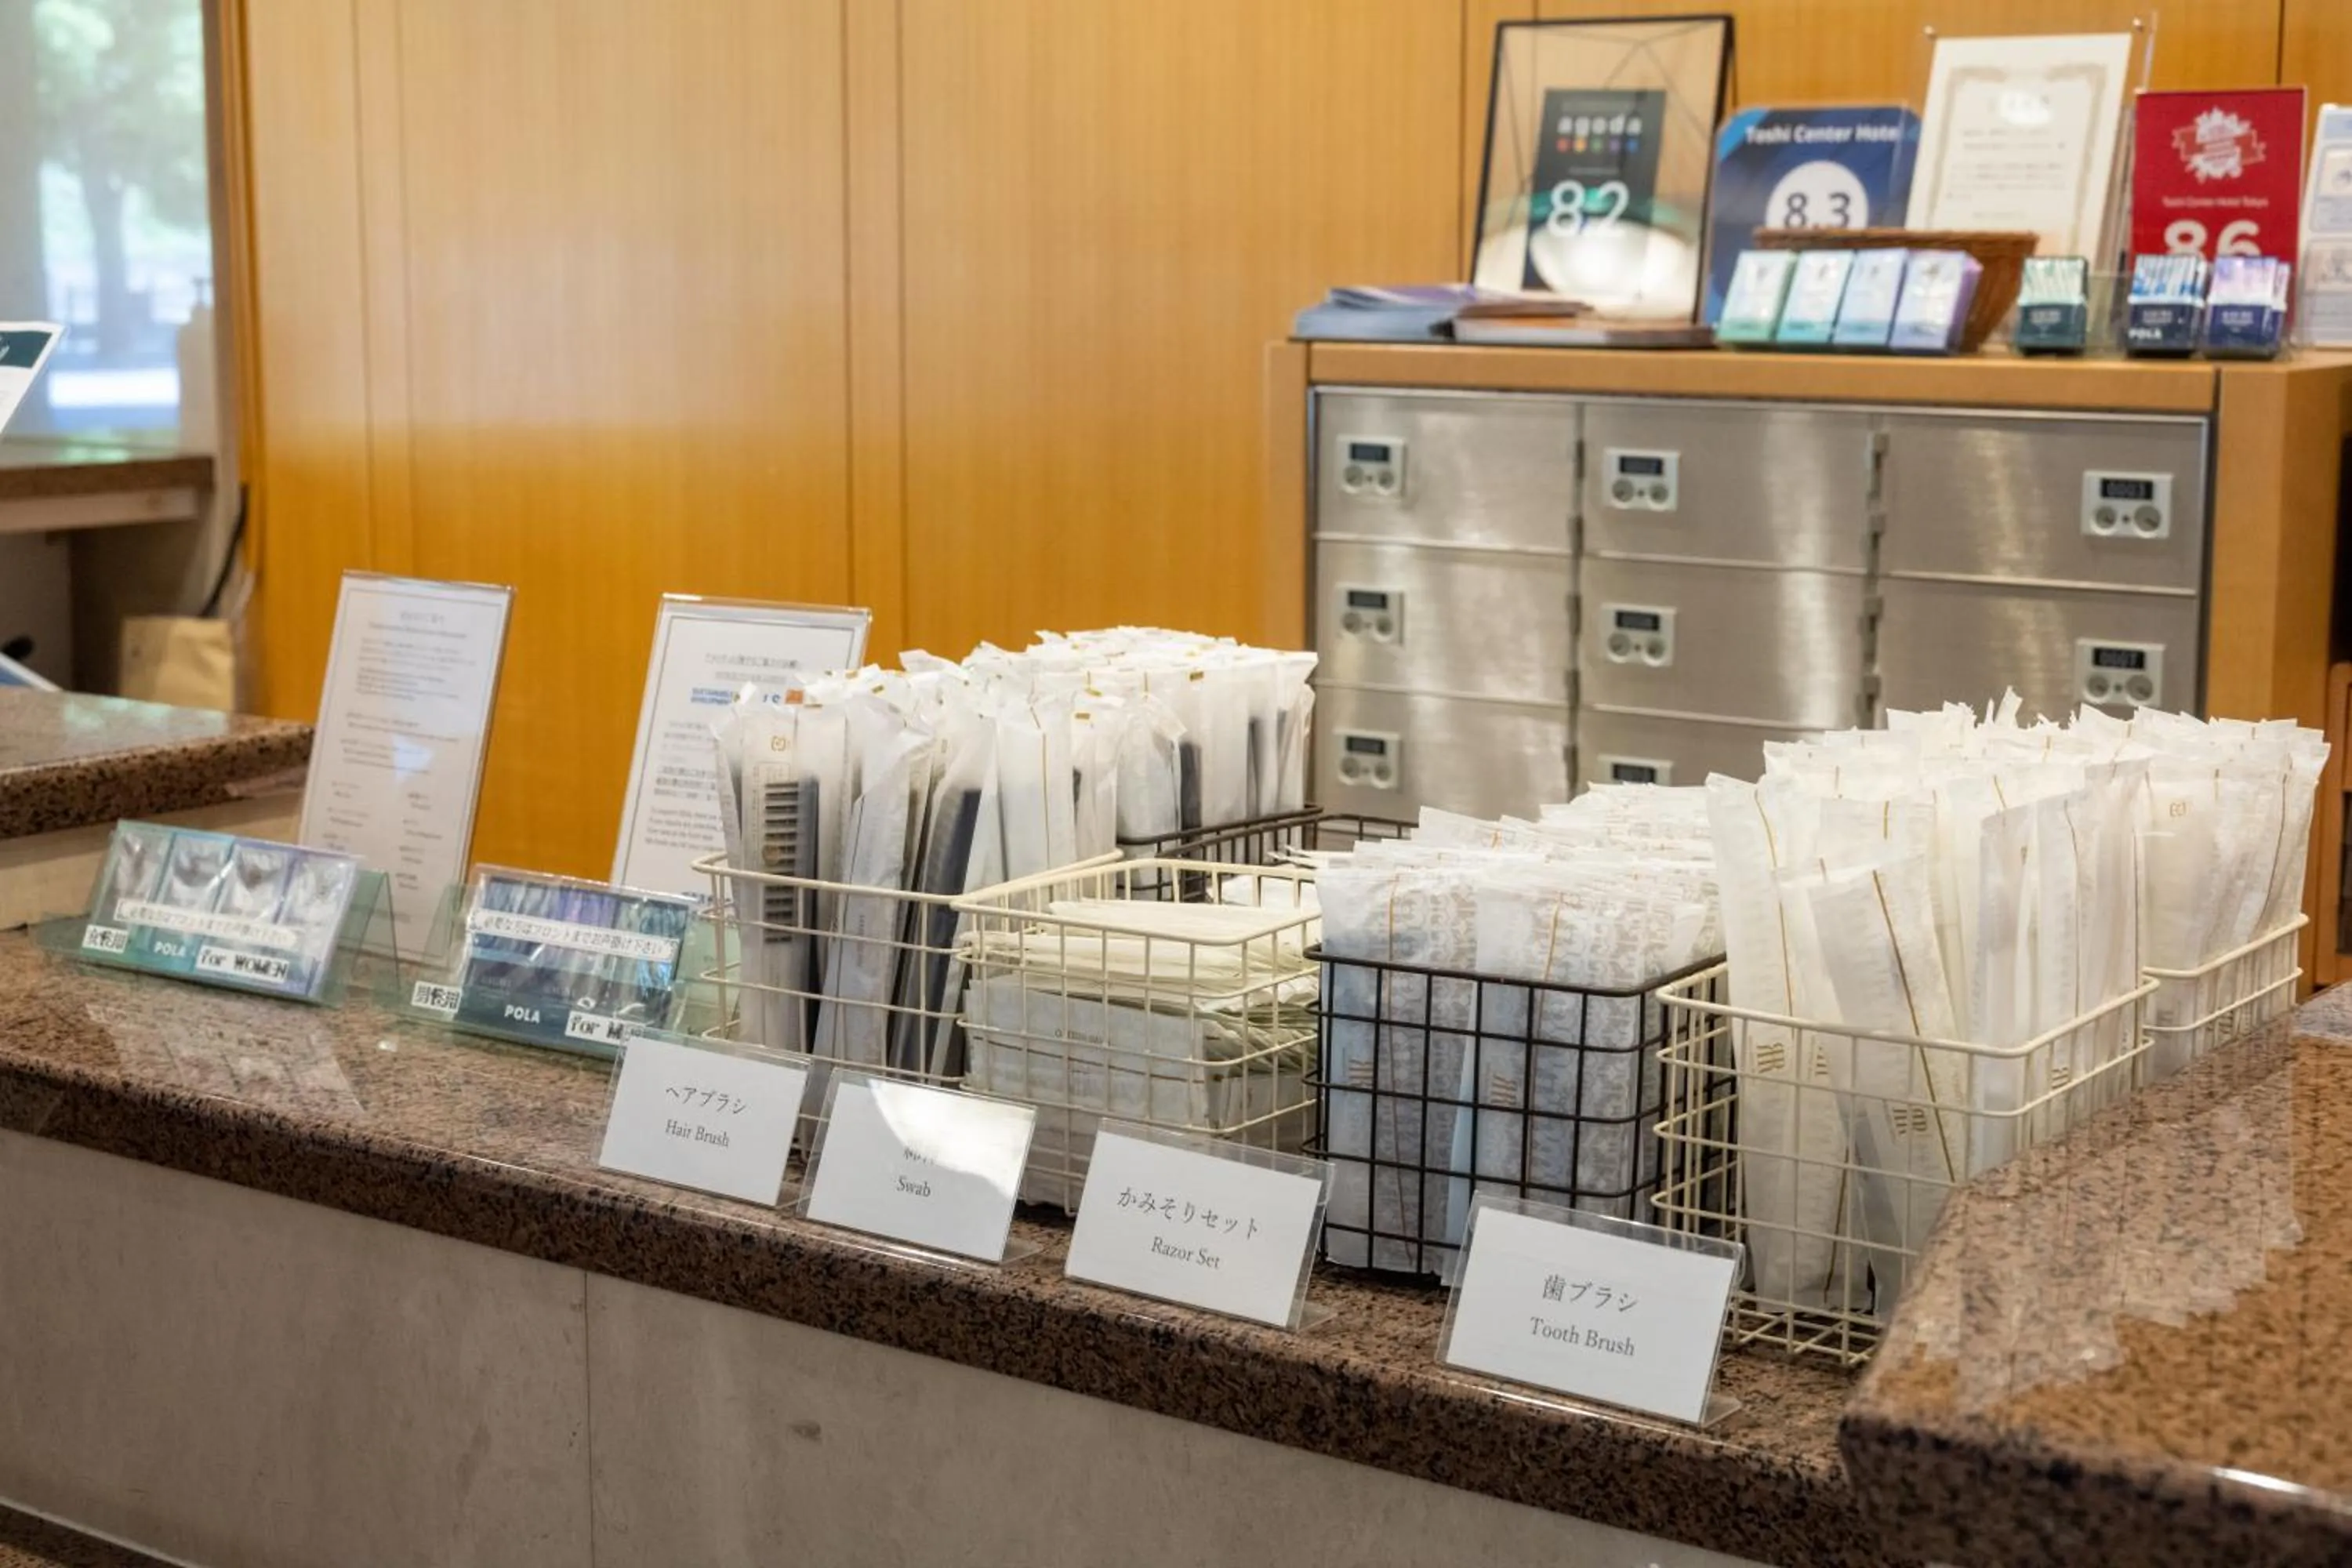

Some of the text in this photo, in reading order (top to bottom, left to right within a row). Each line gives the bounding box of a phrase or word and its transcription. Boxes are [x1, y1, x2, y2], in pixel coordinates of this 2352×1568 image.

[1557, 113, 1642, 137] agoda
[1794, 123, 1853, 143] Center
[154, 941, 187, 956] POLA
[201, 949, 288, 978] for WOMEN
[504, 1004, 541, 1024] POLA
[571, 1016, 601, 1036] for
[665, 1084, 748, 1116] ヘアブラシ
[664, 1120, 731, 1149] Hair Brush
[896, 1174, 931, 1197] Swab
[1116, 1186, 1258, 1240] かみそりセット
[1150, 1236, 1221, 1270] Razor Set
[1541, 1273, 1639, 1312] 歯ブラシ
[1530, 1316, 1635, 1357] Tooth Brush
